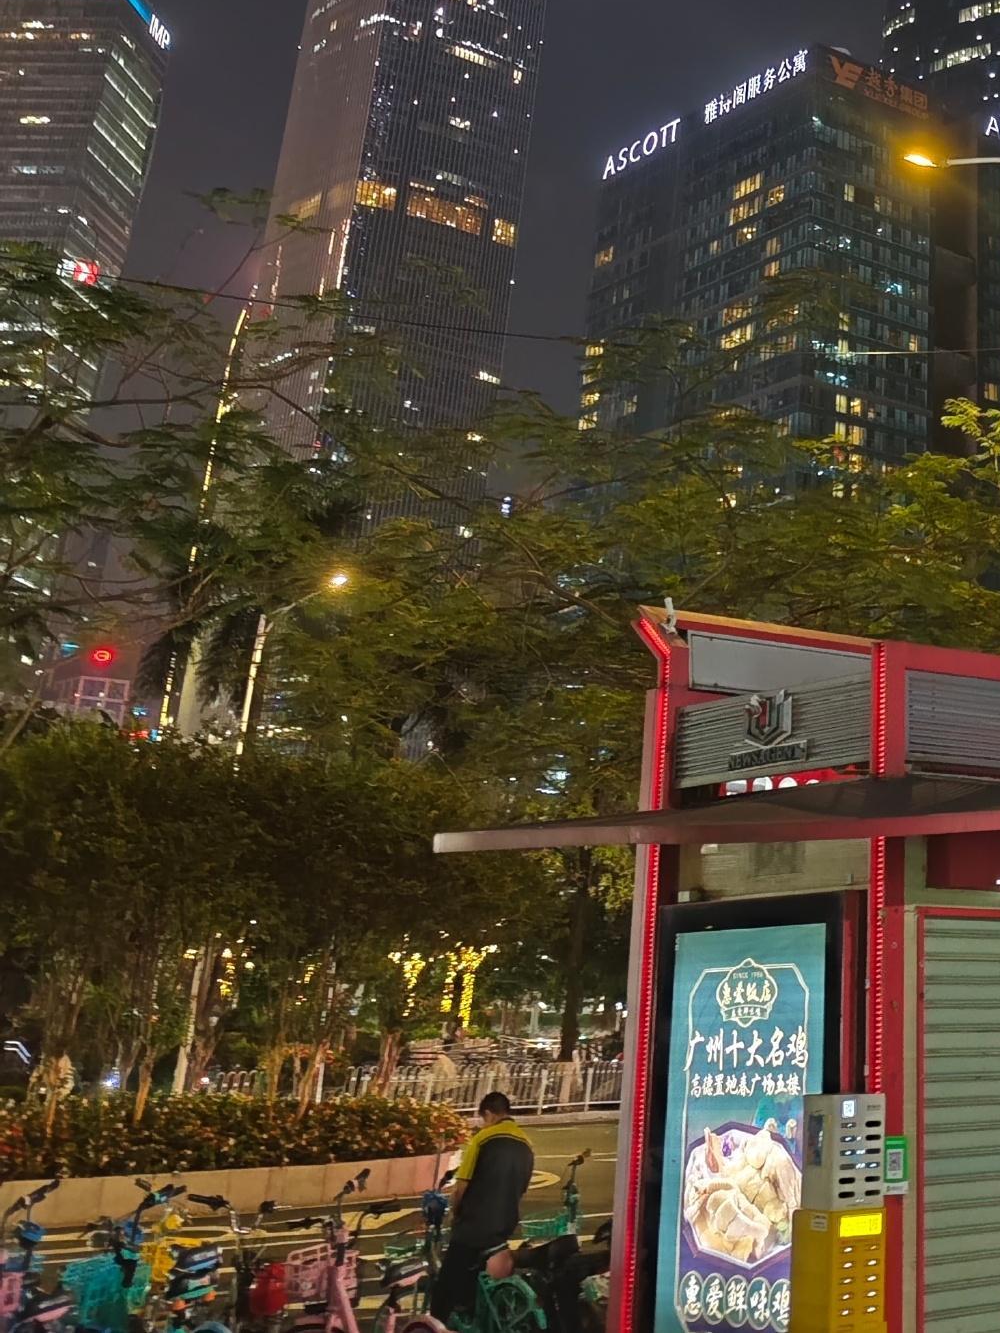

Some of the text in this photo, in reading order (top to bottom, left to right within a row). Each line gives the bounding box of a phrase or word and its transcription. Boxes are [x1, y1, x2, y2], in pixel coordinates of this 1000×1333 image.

[149, 13, 171, 49] IMP
[704, 49, 808, 124] 雅诗阁服务公寓
[602, 118, 680, 179] ASCOTT
[683, 1025, 809, 1071] 广州十大名鸡
[684, 1275, 790, 1325] 惠爱鲜味鸡
